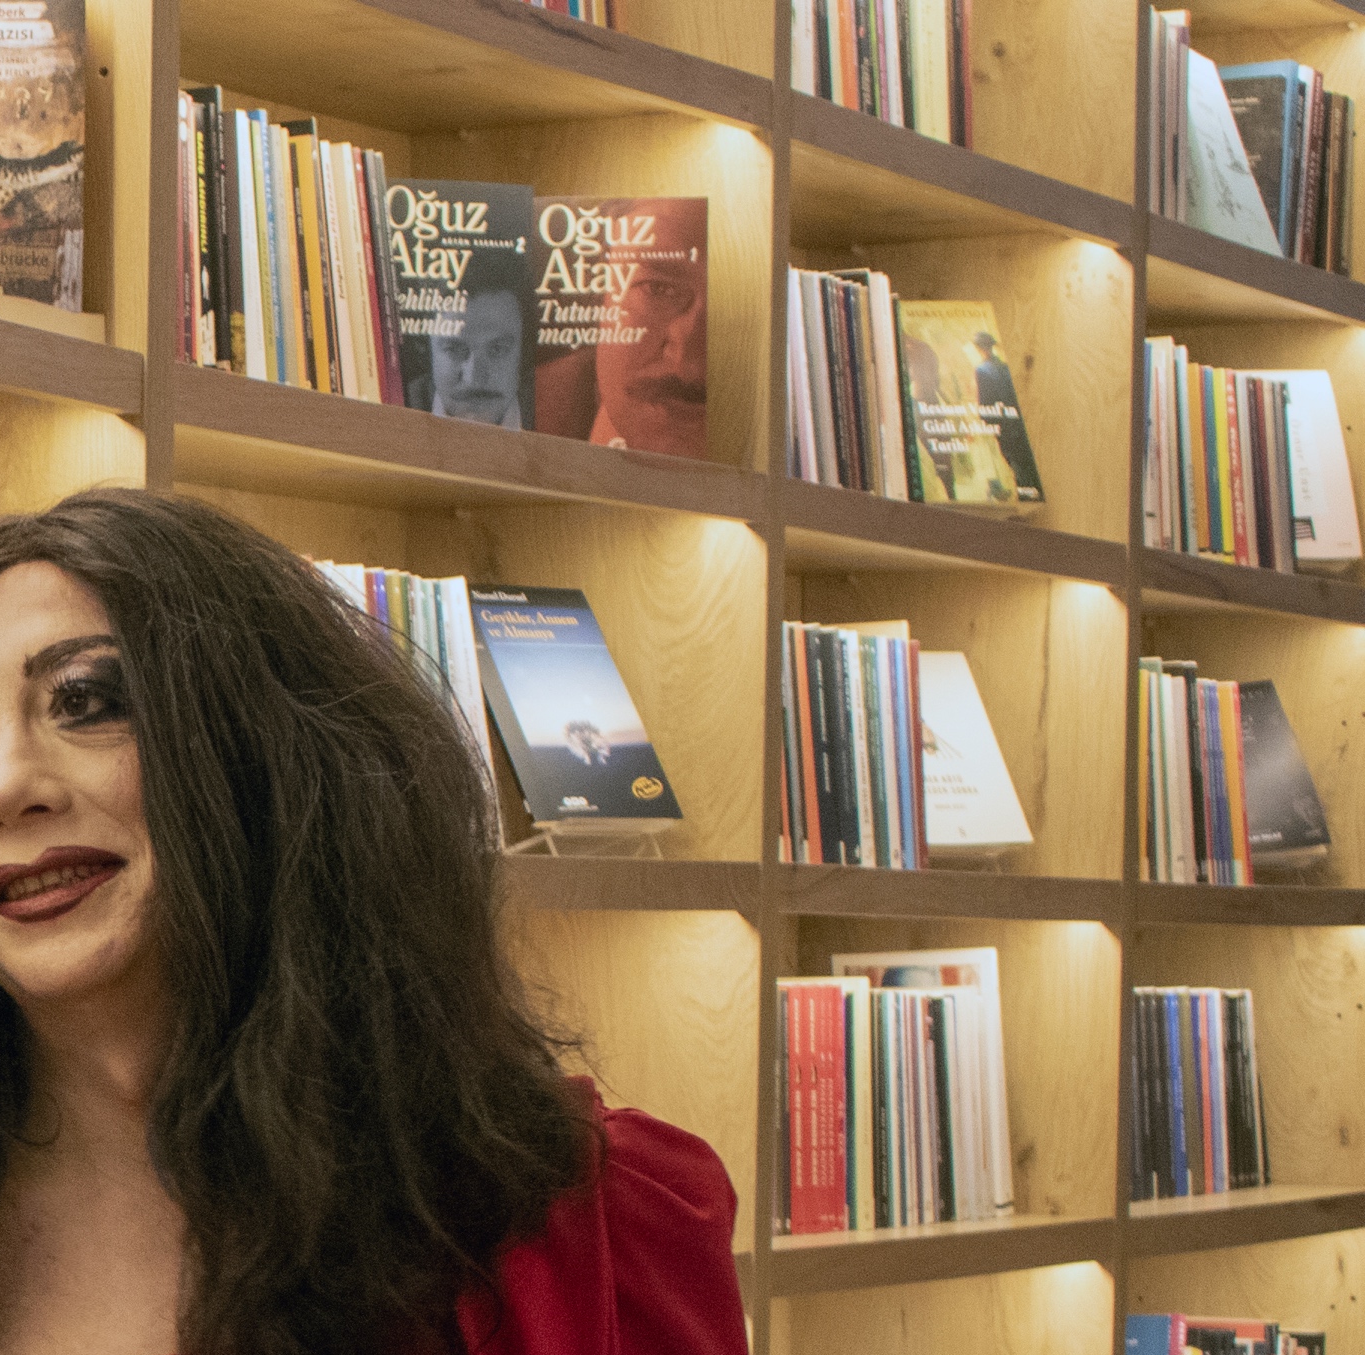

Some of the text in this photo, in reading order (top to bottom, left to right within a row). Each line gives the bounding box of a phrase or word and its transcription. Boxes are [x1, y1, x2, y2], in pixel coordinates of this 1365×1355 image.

[386, 185, 489, 241] Oğuz
[539, 204, 656, 255] Oğuz
[516, 236, 526, 253] 2
[391, 230, 473, 290] Atay
[535, 248, 639, 303] Atay
[398, 288, 468, 314] ehlikeli
[540, 300, 628, 324] Tutuna-
[537, 323, 648, 350] mayanlar
[923, 419, 956, 434] Gizli
[927, 438, 970, 452] Tarihi
